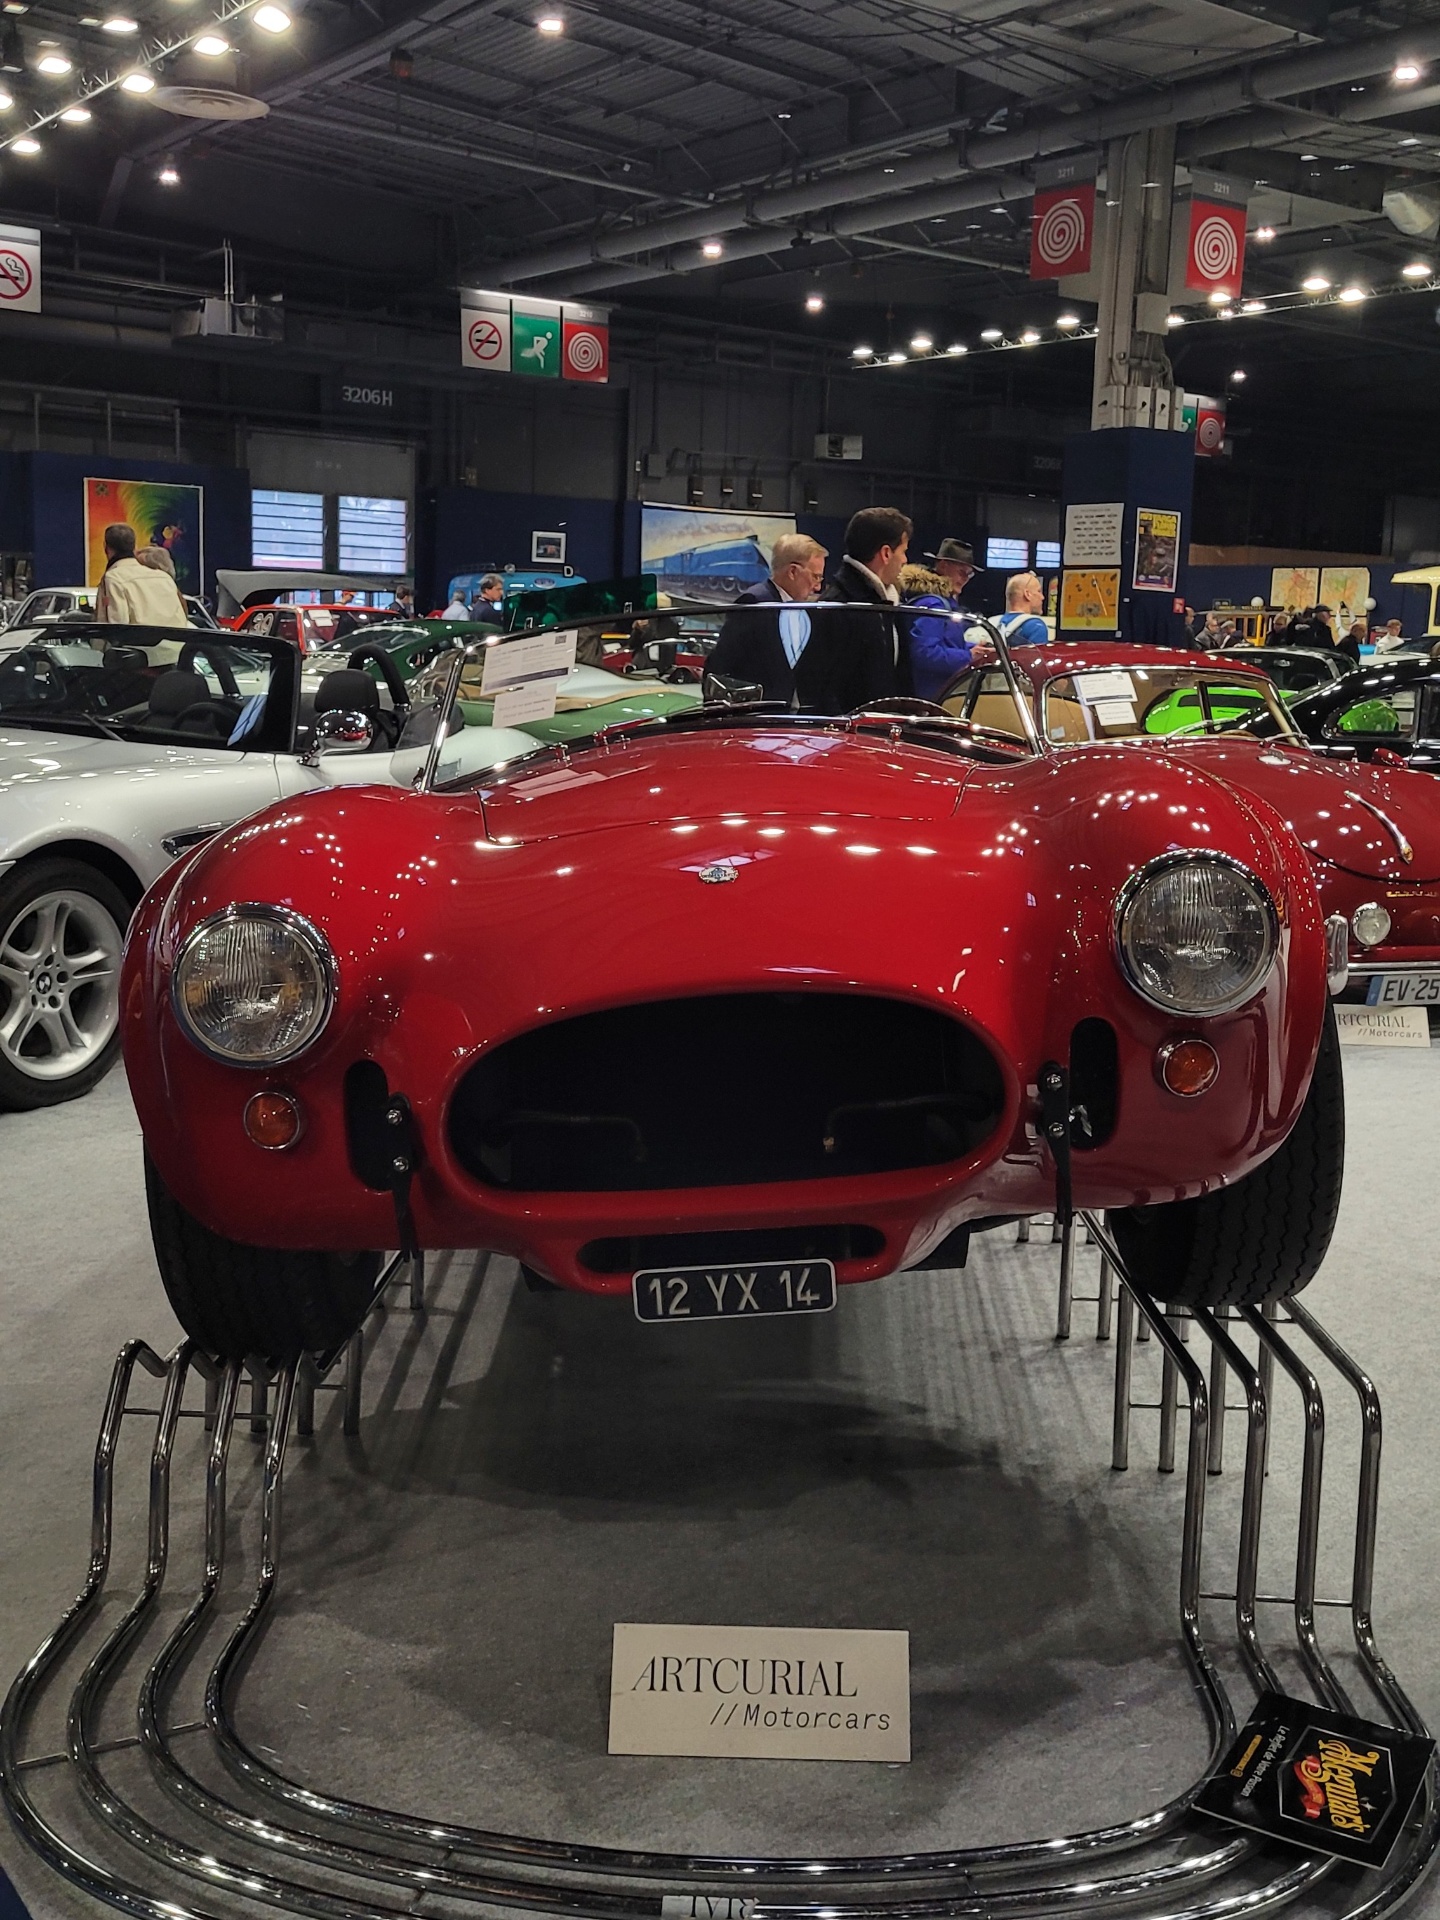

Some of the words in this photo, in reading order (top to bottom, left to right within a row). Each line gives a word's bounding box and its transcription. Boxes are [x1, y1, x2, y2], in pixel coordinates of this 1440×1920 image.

[1058, 166, 1075, 179] 3211
[1213, 182, 1230, 194] 3211
[342, 386, 393, 407] 3206H
[1337, 1013, 1411, 1028] RTCURIAL
[649, 1277, 690, 1316] 12
[705, 1272, 760, 1312] YX
[779, 1267, 821, 1308] 14
[631, 1655, 859, 1698] ARTCURIAL
[710, 1702, 891, 1731] //Motorcars
[1277, 1725, 1291, 1735] Le
[1262, 1751, 1277, 1761] de
[1253, 1760, 1272, 1776] Votre
[1240, 1774, 1262, 1797] Passion
[1301, 1739, 1381, 1833] Meguiar's
